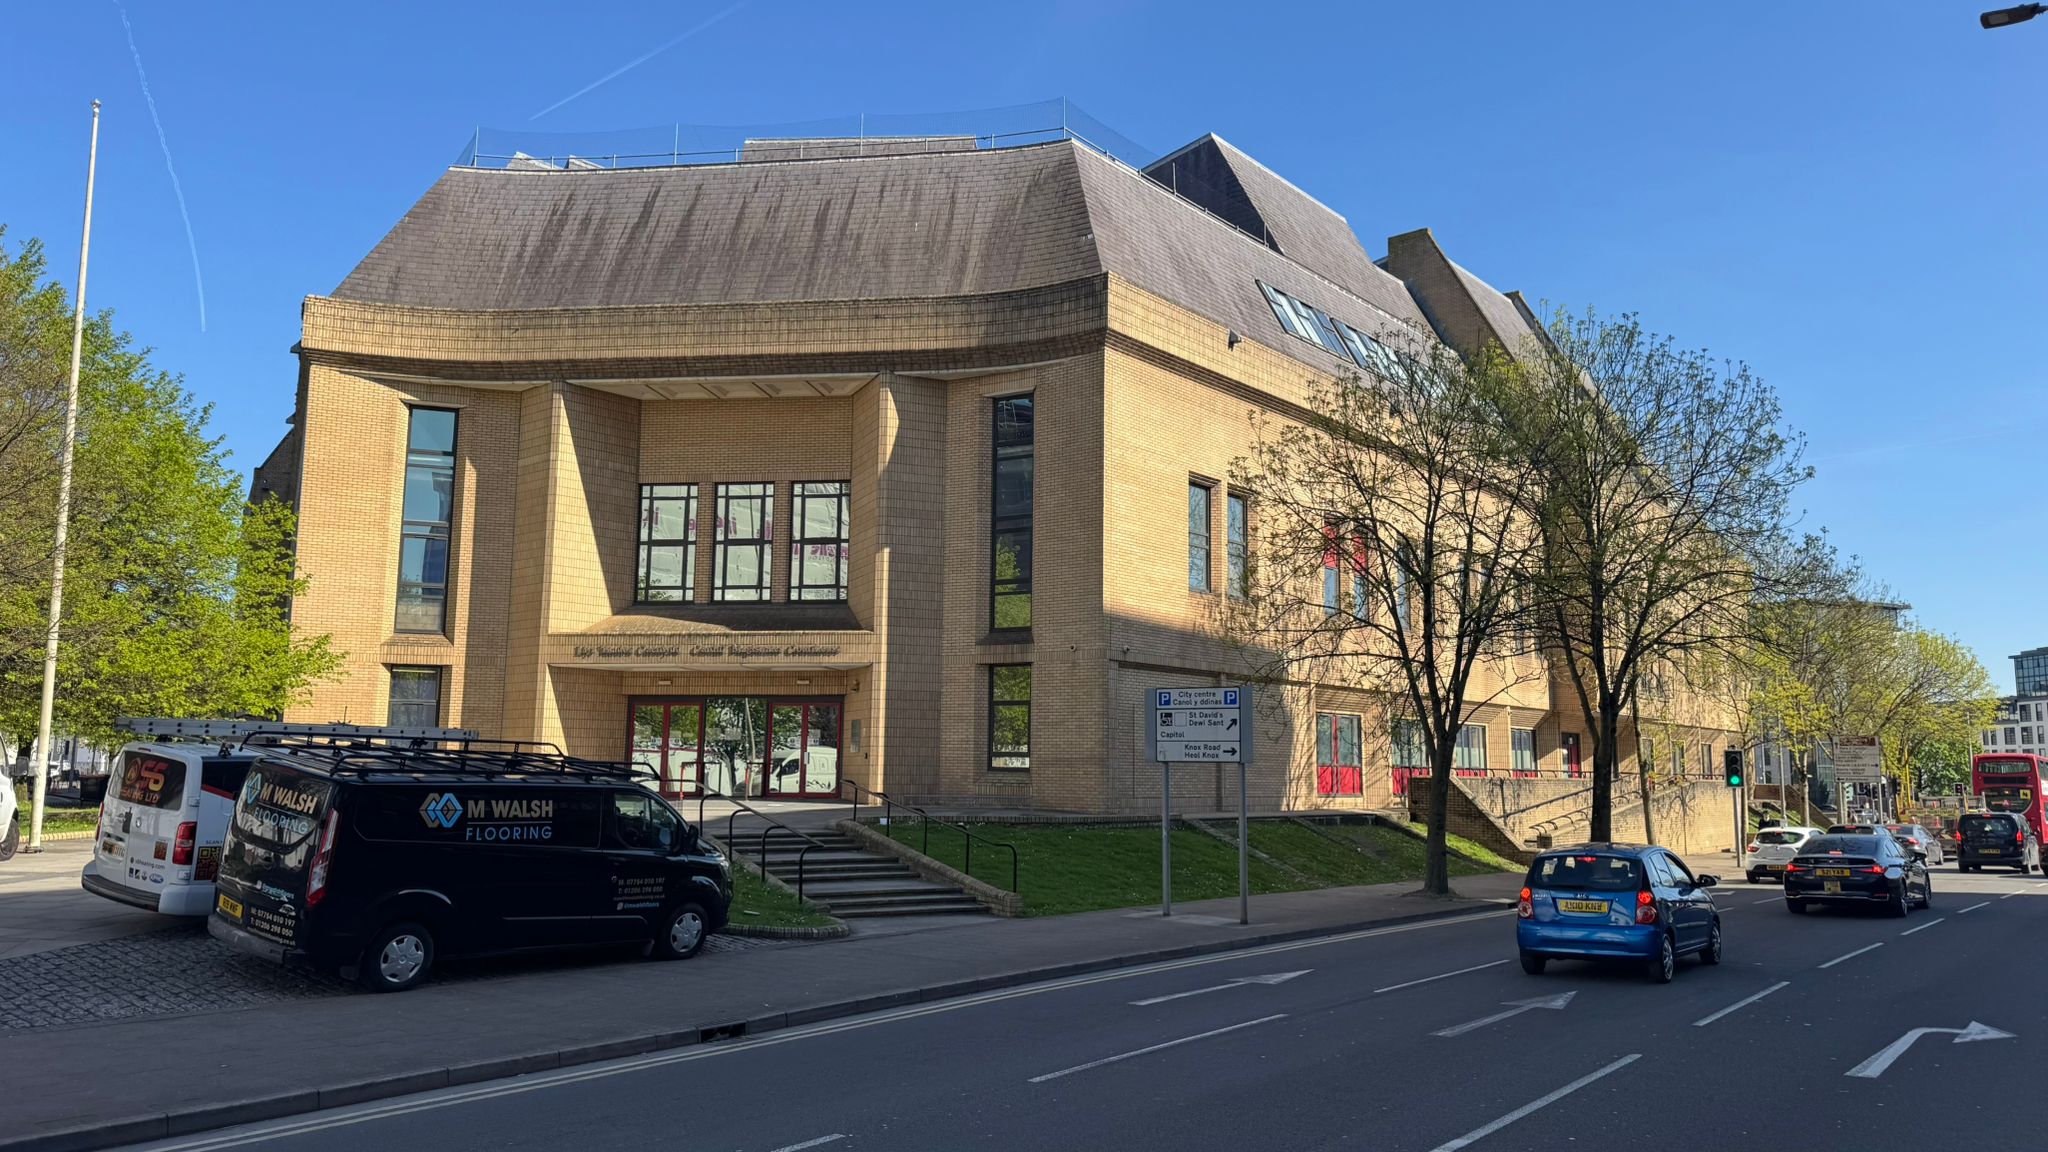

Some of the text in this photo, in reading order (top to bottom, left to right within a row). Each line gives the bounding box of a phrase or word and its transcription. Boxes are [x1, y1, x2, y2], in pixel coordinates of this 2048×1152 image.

[1160, 731, 1185, 739] Capitol
[260, 782, 318, 814] M WALSH
[467, 800, 553, 818] M WALSH
[253, 806, 308, 834] FLOORING
[466, 826, 552, 840] FLOORING
[284, 917, 296, 927] 197
